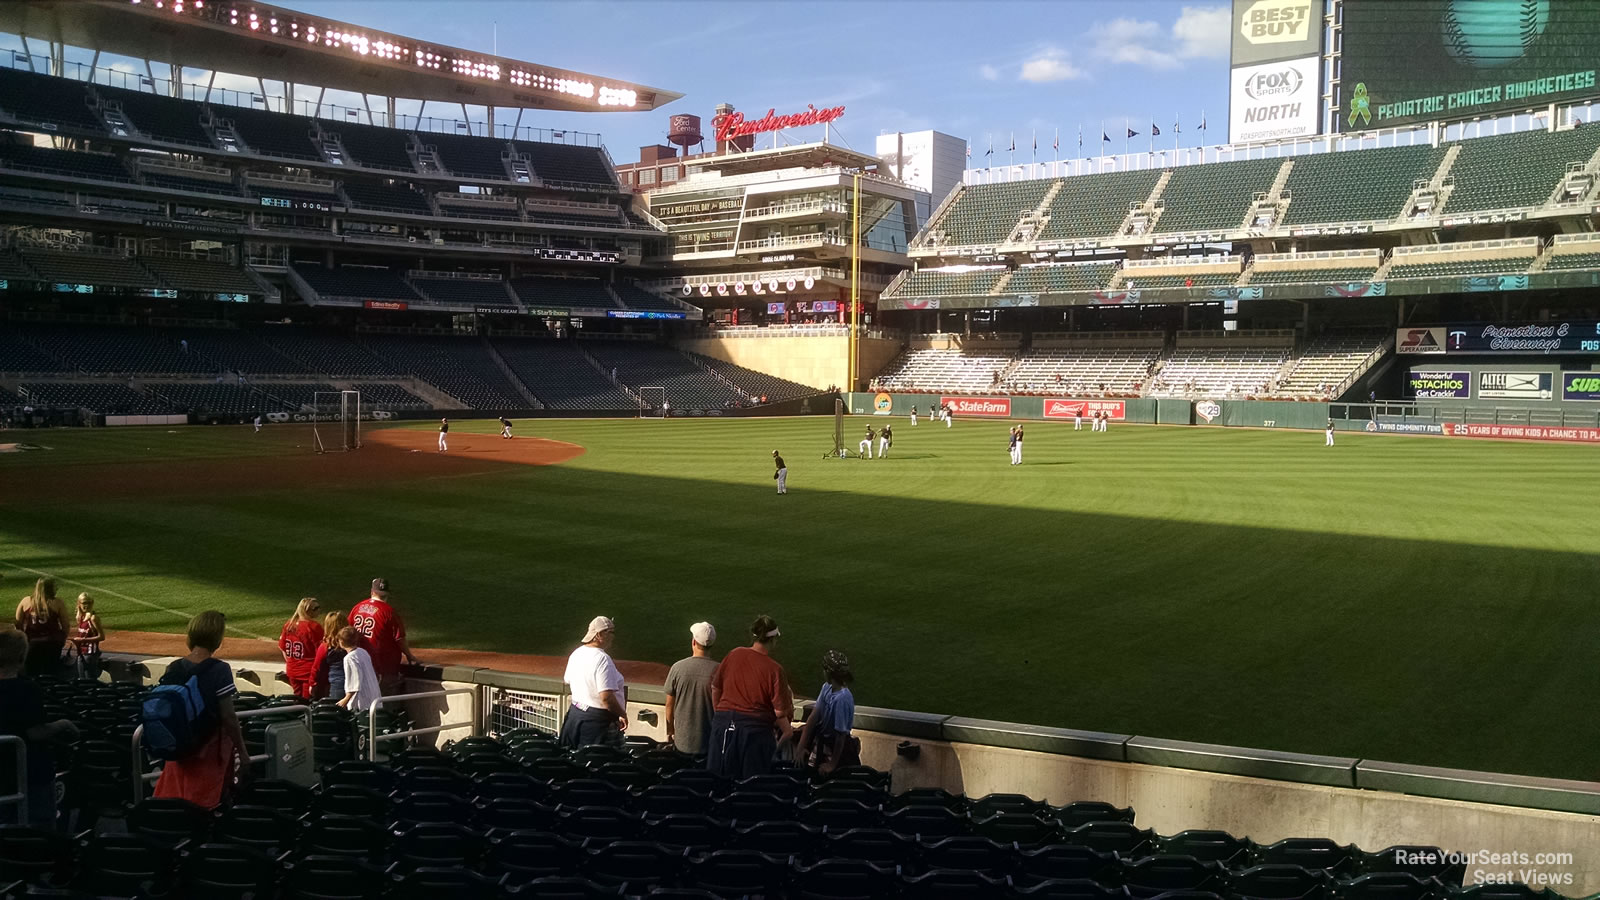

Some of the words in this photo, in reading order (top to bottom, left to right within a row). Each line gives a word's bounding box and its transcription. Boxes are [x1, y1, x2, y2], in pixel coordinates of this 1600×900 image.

[1250, 5, 1309, 23] BEST
[1251, 20, 1302, 38] BUY
[1256, 71, 1290, 90] FOX
[1256, 86, 1292, 96] SPORTS
[1378, 96, 1444, 120] PEDIATRIC
[1448, 85, 1501, 110] CANCER
[1505, 70, 1596, 100] AWARENESS
[1244, 102, 1302, 124] NORTH
[674, 116, 690, 126] Ford
[676, 124, 696, 132] Center
[711, 104, 846, 142] Budweiser
[1240, 126, 1307, 140] FOXSPORTSNORTH.COM
[675, 205, 701, 214] BEAUTIFUL
[701, 203, 710, 212] DAY
[719, 200, 742, 209] BASEBALL
[693, 232, 710, 242] TWINS
[1482, 325, 1554, 338] Promotions
[1557, 323, 1569, 337] &
[1490, 336, 1561, 354] Giveaways
[1581, 340, 1600, 351] POS
[1410, 380, 1463, 389] PISTACHIOS
[1482, 374, 1506, 386] ALTEC
[1566, 378, 1600, 392] SUB
[1208, 406, 1219, 416] 29
[1454, 424, 1468, 435] 25
[1469, 427, 1490, 435] YEARS
[1502, 428, 1523, 436] GIVING
[1525, 428, 1541, 437] KIDS
[1549, 430, 1577, 438] CHANCE
[1590, 431, 1600, 440] PL
[354, 614, 375, 638] 22
